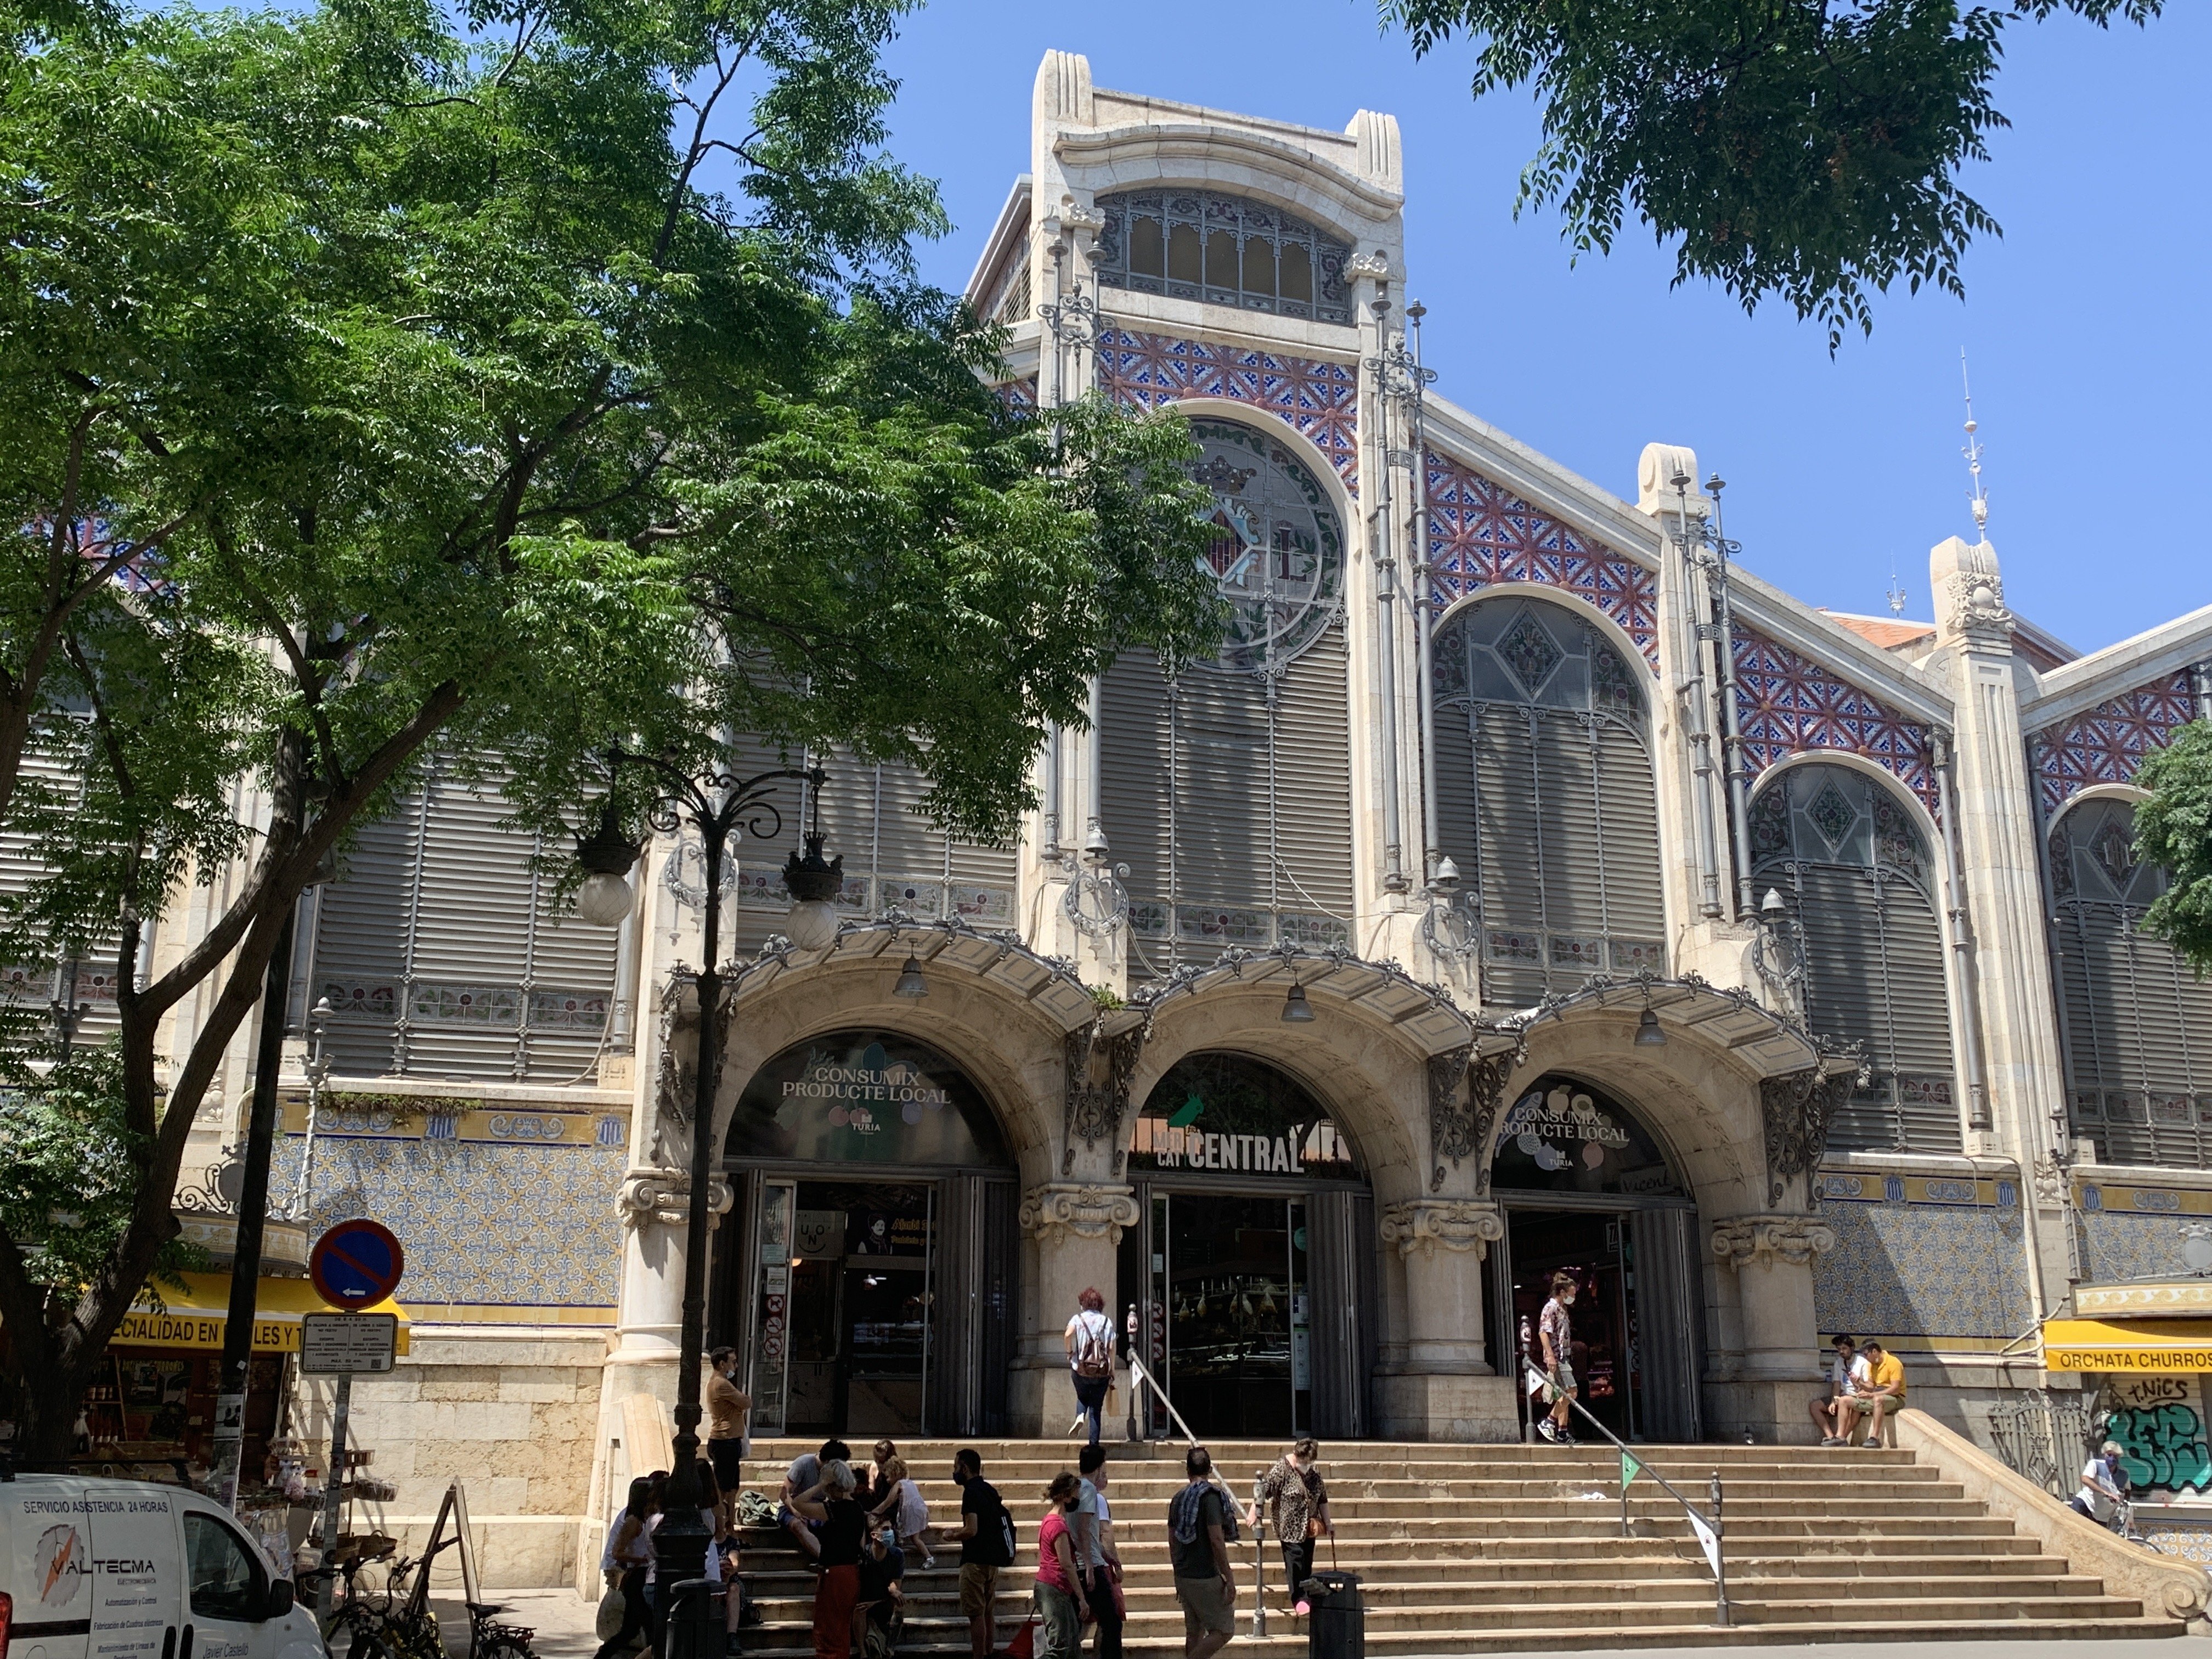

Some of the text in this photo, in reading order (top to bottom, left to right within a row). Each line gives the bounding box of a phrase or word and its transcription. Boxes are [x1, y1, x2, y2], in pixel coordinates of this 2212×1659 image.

[815, 1066, 921, 1086] CONSUMIX
[782, 1081, 951, 1104] PRODUCTE LOCAL
[1514, 1107, 1603, 1125] CONSUMIX
[852, 1123, 881, 1132] TURIA
[1500, 1121, 1629, 1142] RODUCTE LOCAL
[1153, 1131, 1181, 1149] MER
[1156, 1150, 1180, 1167] CAT
[1188, 1131, 1305, 1173] CENTRAL
[1549, 1158, 1574, 1167] TURIA
[111, 1318, 193, 1341] CIALIDAD
[199, 1323, 218, 1342] EN
[284, 1327, 293, 1345] Y
[2060, 1353, 2134, 1368] ORCHATA
[23, 1501, 168, 1514] SERVICIO ASISTENCIA 24 HORAS
[94, 1621, 119, 1630] Fabricación
[126, 1620, 143, 1628] Cuadros
[203, 1645, 223, 1659] Javier
